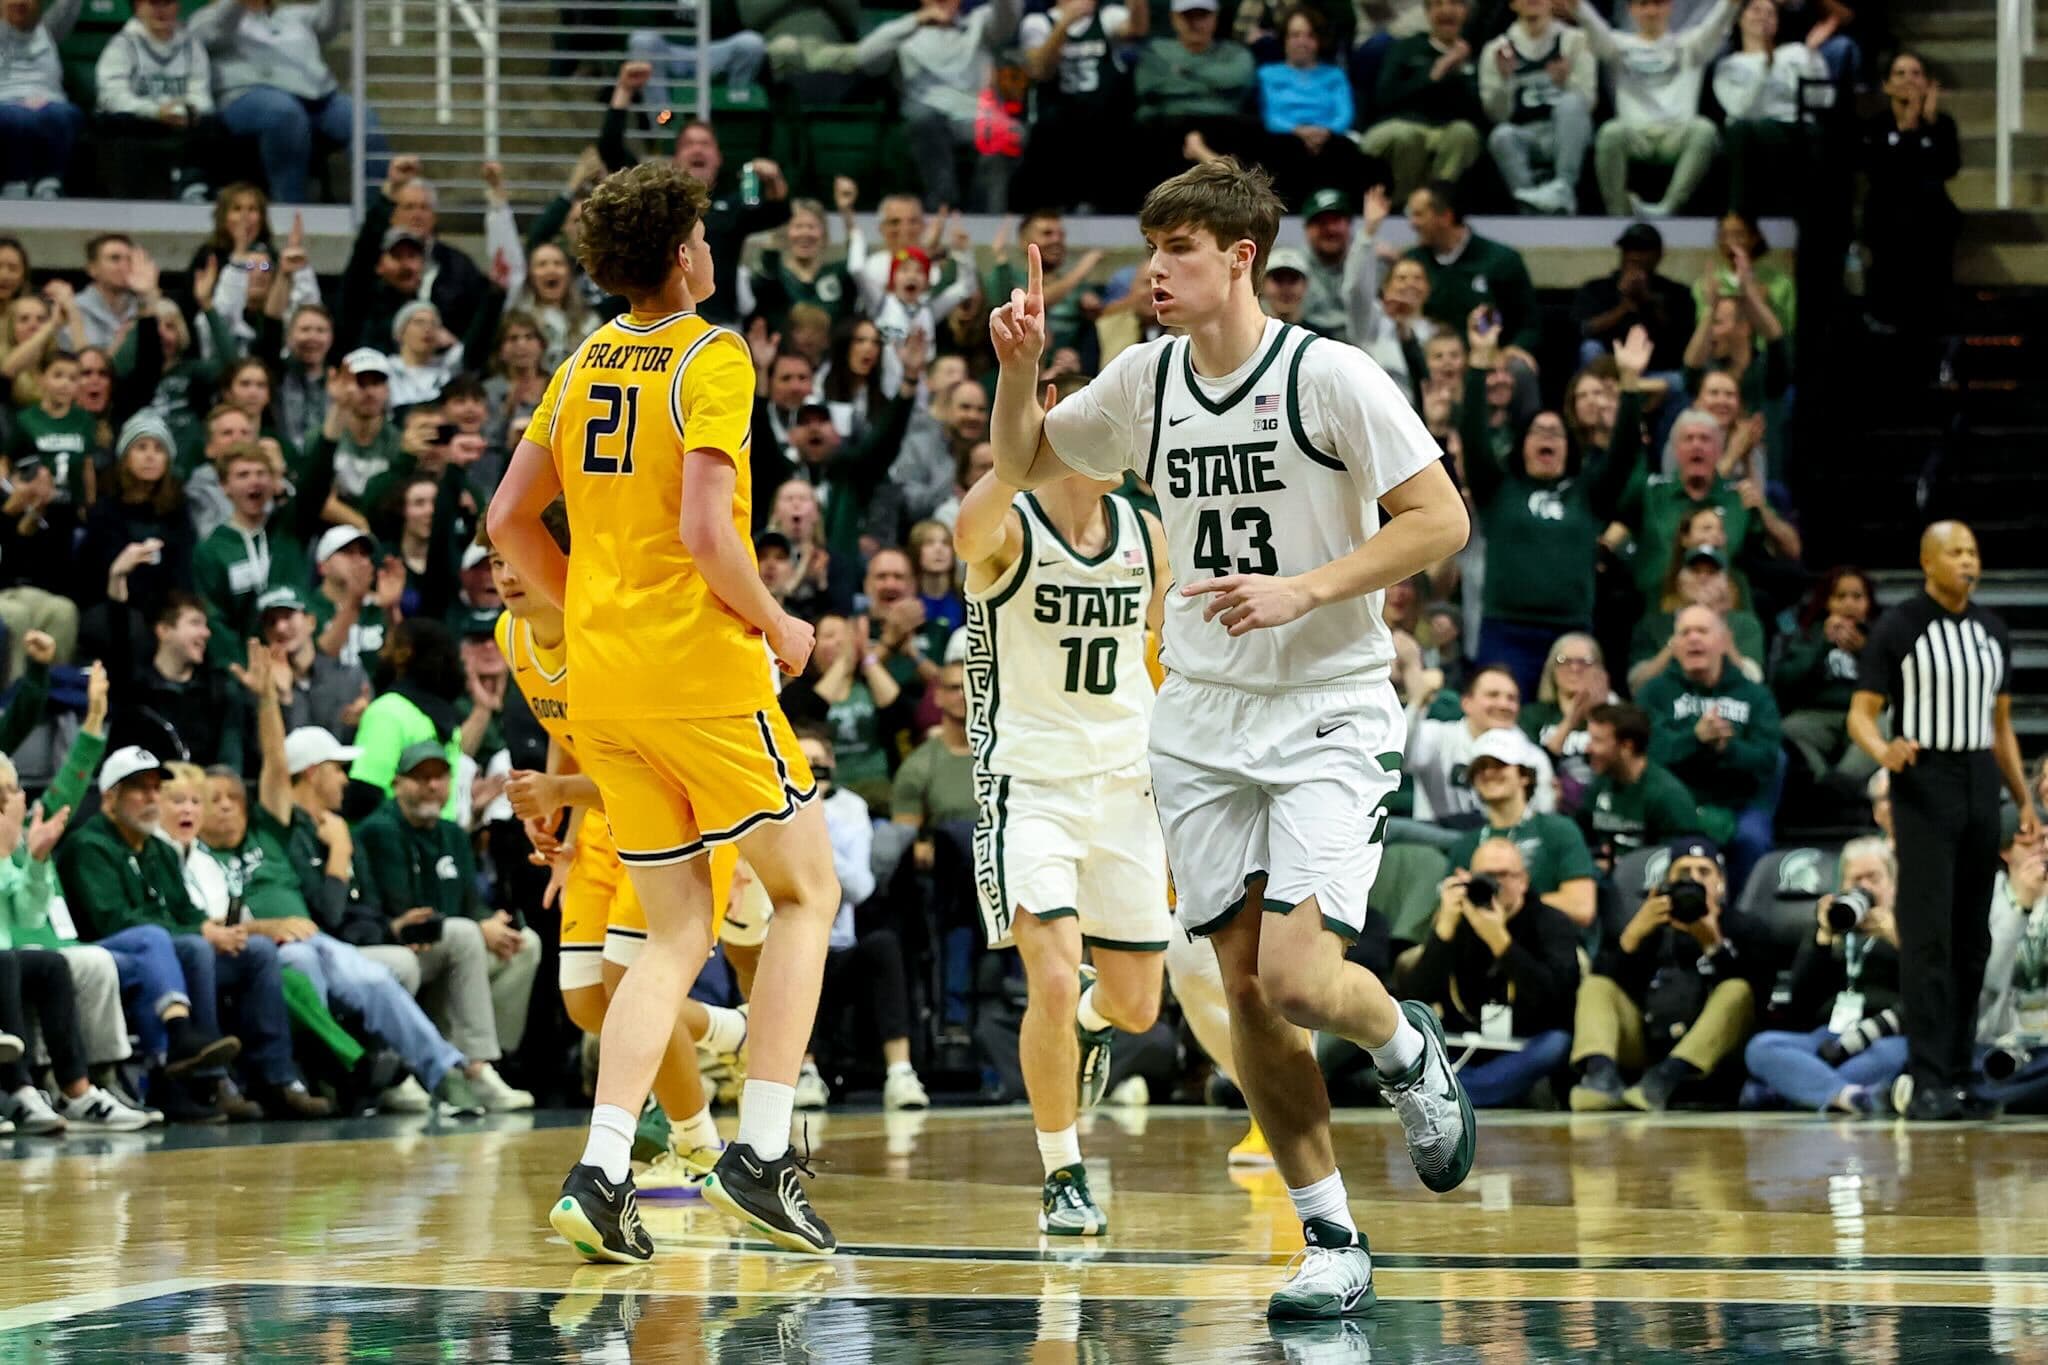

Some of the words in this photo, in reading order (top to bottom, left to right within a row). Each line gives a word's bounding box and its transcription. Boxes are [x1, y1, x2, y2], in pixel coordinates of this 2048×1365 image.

[581, 343, 674, 373] PRAYTOR
[582, 382, 641, 476] 21
[1167, 440, 1287, 499] STATE
[1193, 506, 1279, 577] 43
[1034, 584, 1143, 628] STATE
[1059, 636, 1119, 695] 10
